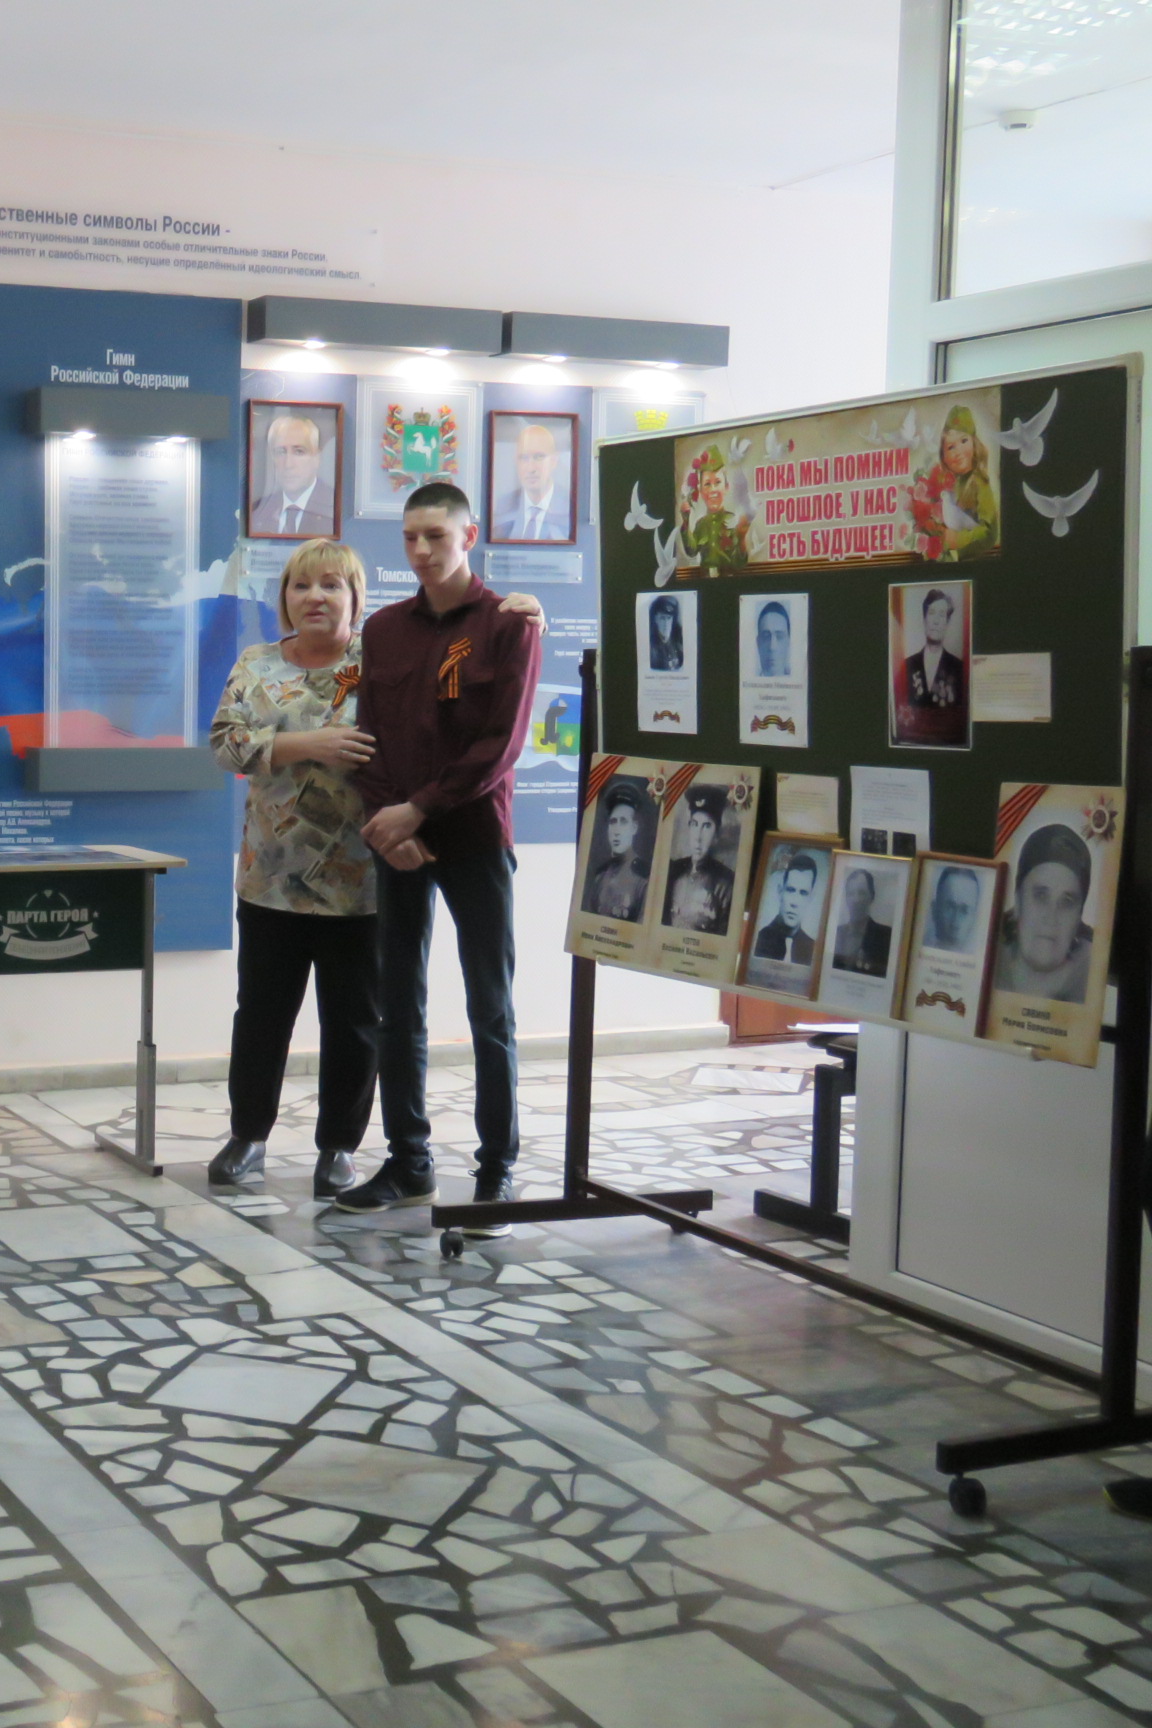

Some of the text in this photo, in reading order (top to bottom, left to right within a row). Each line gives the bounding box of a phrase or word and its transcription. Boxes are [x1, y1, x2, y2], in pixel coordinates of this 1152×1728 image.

[83, 212, 158, 232] символы
[162, 215, 221, 236] России
[91, 236, 140, 248] законами
[142, 238, 181, 251] особые
[183, 242, 258, 256] отличительные
[261, 248, 289, 260] знаки
[39, 248, 46, 258] и
[126, 254, 170, 268] несущие
[248, 264, 327, 278] идеологический
[106, 349, 135, 366] Гимн
[50, 365, 189, 391] Российской Федерации
[754, 447, 911, 493] ПОКА МЫ ПОМНИМ
[765, 485, 898, 526] ПРОШЛОЕ, У НАС
[767, 522, 895, 560] ЕСТЬ БУДУЩЕЕ!
[6, 908, 89, 925] ПАРТА ГЕРОЯ
